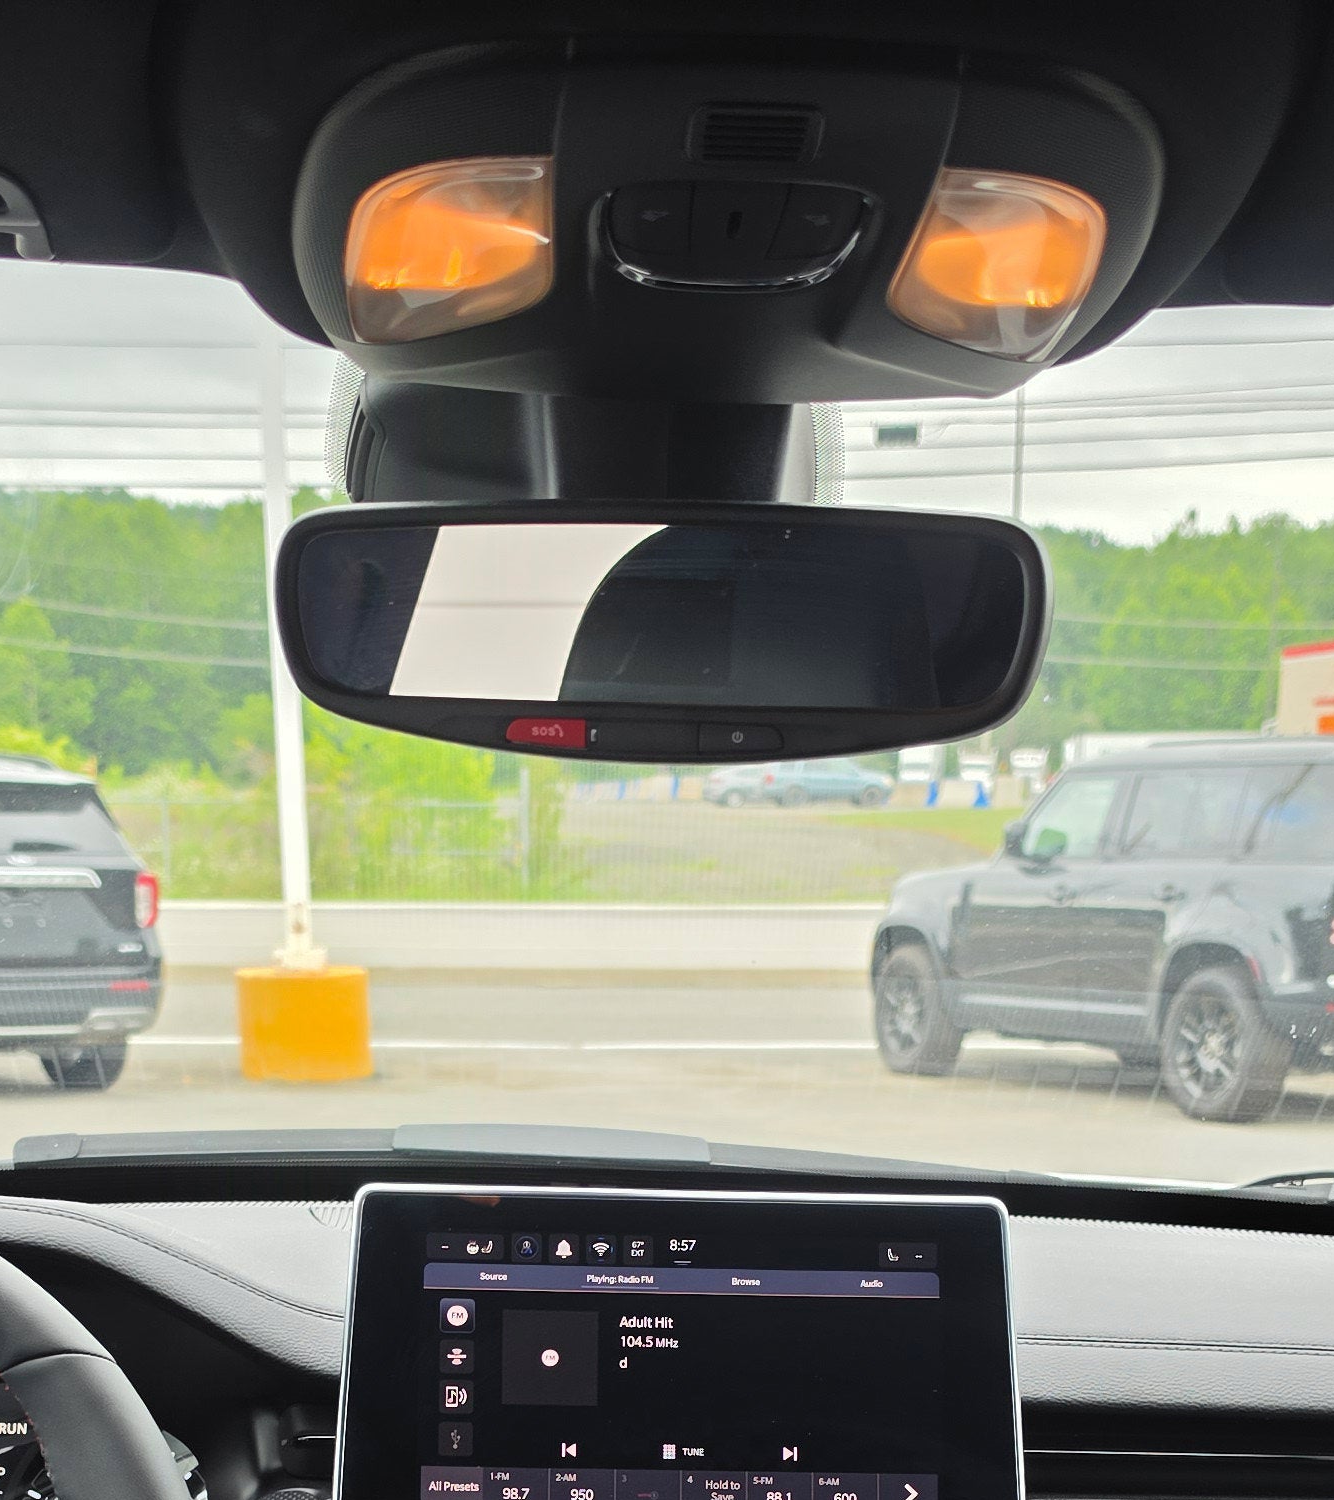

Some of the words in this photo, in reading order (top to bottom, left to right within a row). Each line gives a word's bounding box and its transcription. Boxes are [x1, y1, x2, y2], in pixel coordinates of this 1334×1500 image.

[532, 725, 555, 737] SOS
[669, 1239, 696, 1251] 8:57
[479, 1271, 508, 1281] Source
[586, 1274, 617, 1285] Playing:
[618, 1275, 640, 1284] Radio
[641, 1276, 654, 1284] FM
[731, 1277, 761, 1286] Browse
[860, 1279, 884, 1288] Audio
[451, 1311, 464, 1319] FM
[619, 1315, 653, 1328] Adult
[655, 1316, 674, 1329] Hit
[620, 1335, 654, 1348] 104.5
[655, 1337, 679, 1349] MHz
[619, 1356, 628, 1369] d
[682, 1447, 705, 1457] TUNE
[490, 1472, 510, 1482] 1-FM
[555, 1473, 577, 1482] 2-AM
[687, 1475, 694, 1484] 4
[753, 1476, 774, 1486] 5-FM
[818, 1477, 840, 1486] 6-AM
[428, 1481, 443, 1492] All
[444, 1482, 480, 1492] Presets
[705, 1479, 729, 1490] Hold
[730, 1480, 741, 1491] to
[502, 1488, 530, 1500] 98.7
[570, 1489, 594, 1500] 950
